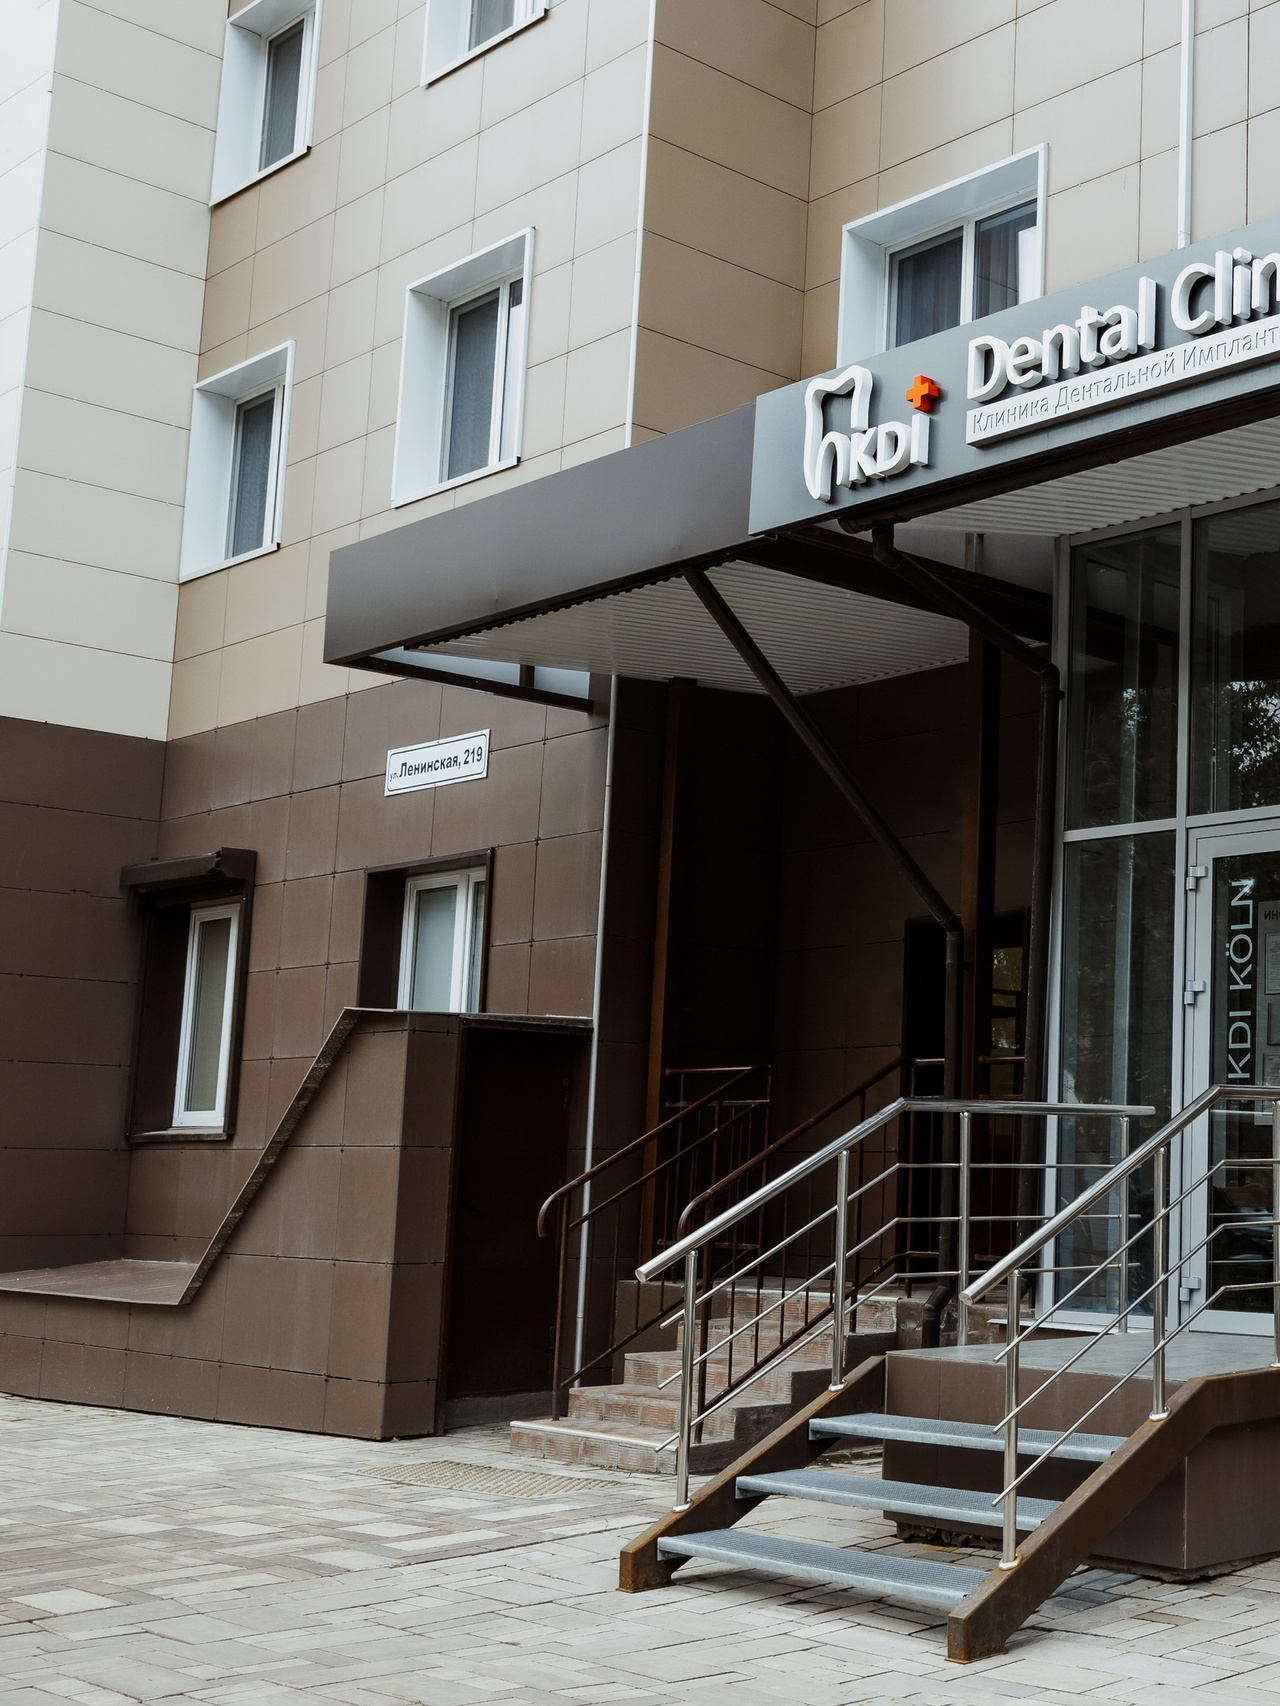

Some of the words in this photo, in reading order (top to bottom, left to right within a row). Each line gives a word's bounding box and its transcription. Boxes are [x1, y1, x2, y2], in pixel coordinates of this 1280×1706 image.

[967, 276, 1157, 402] Dental
[972, 396, 1049, 434] Клиника
[1054, 352, 1175, 414] Дентальной
[399, 755, 461, 778] Ленинская,
[463, 746, 483, 766] 219
[1225, 879, 1254, 990] KÖLN
[1228, 1010, 1251, 1079] KDI
